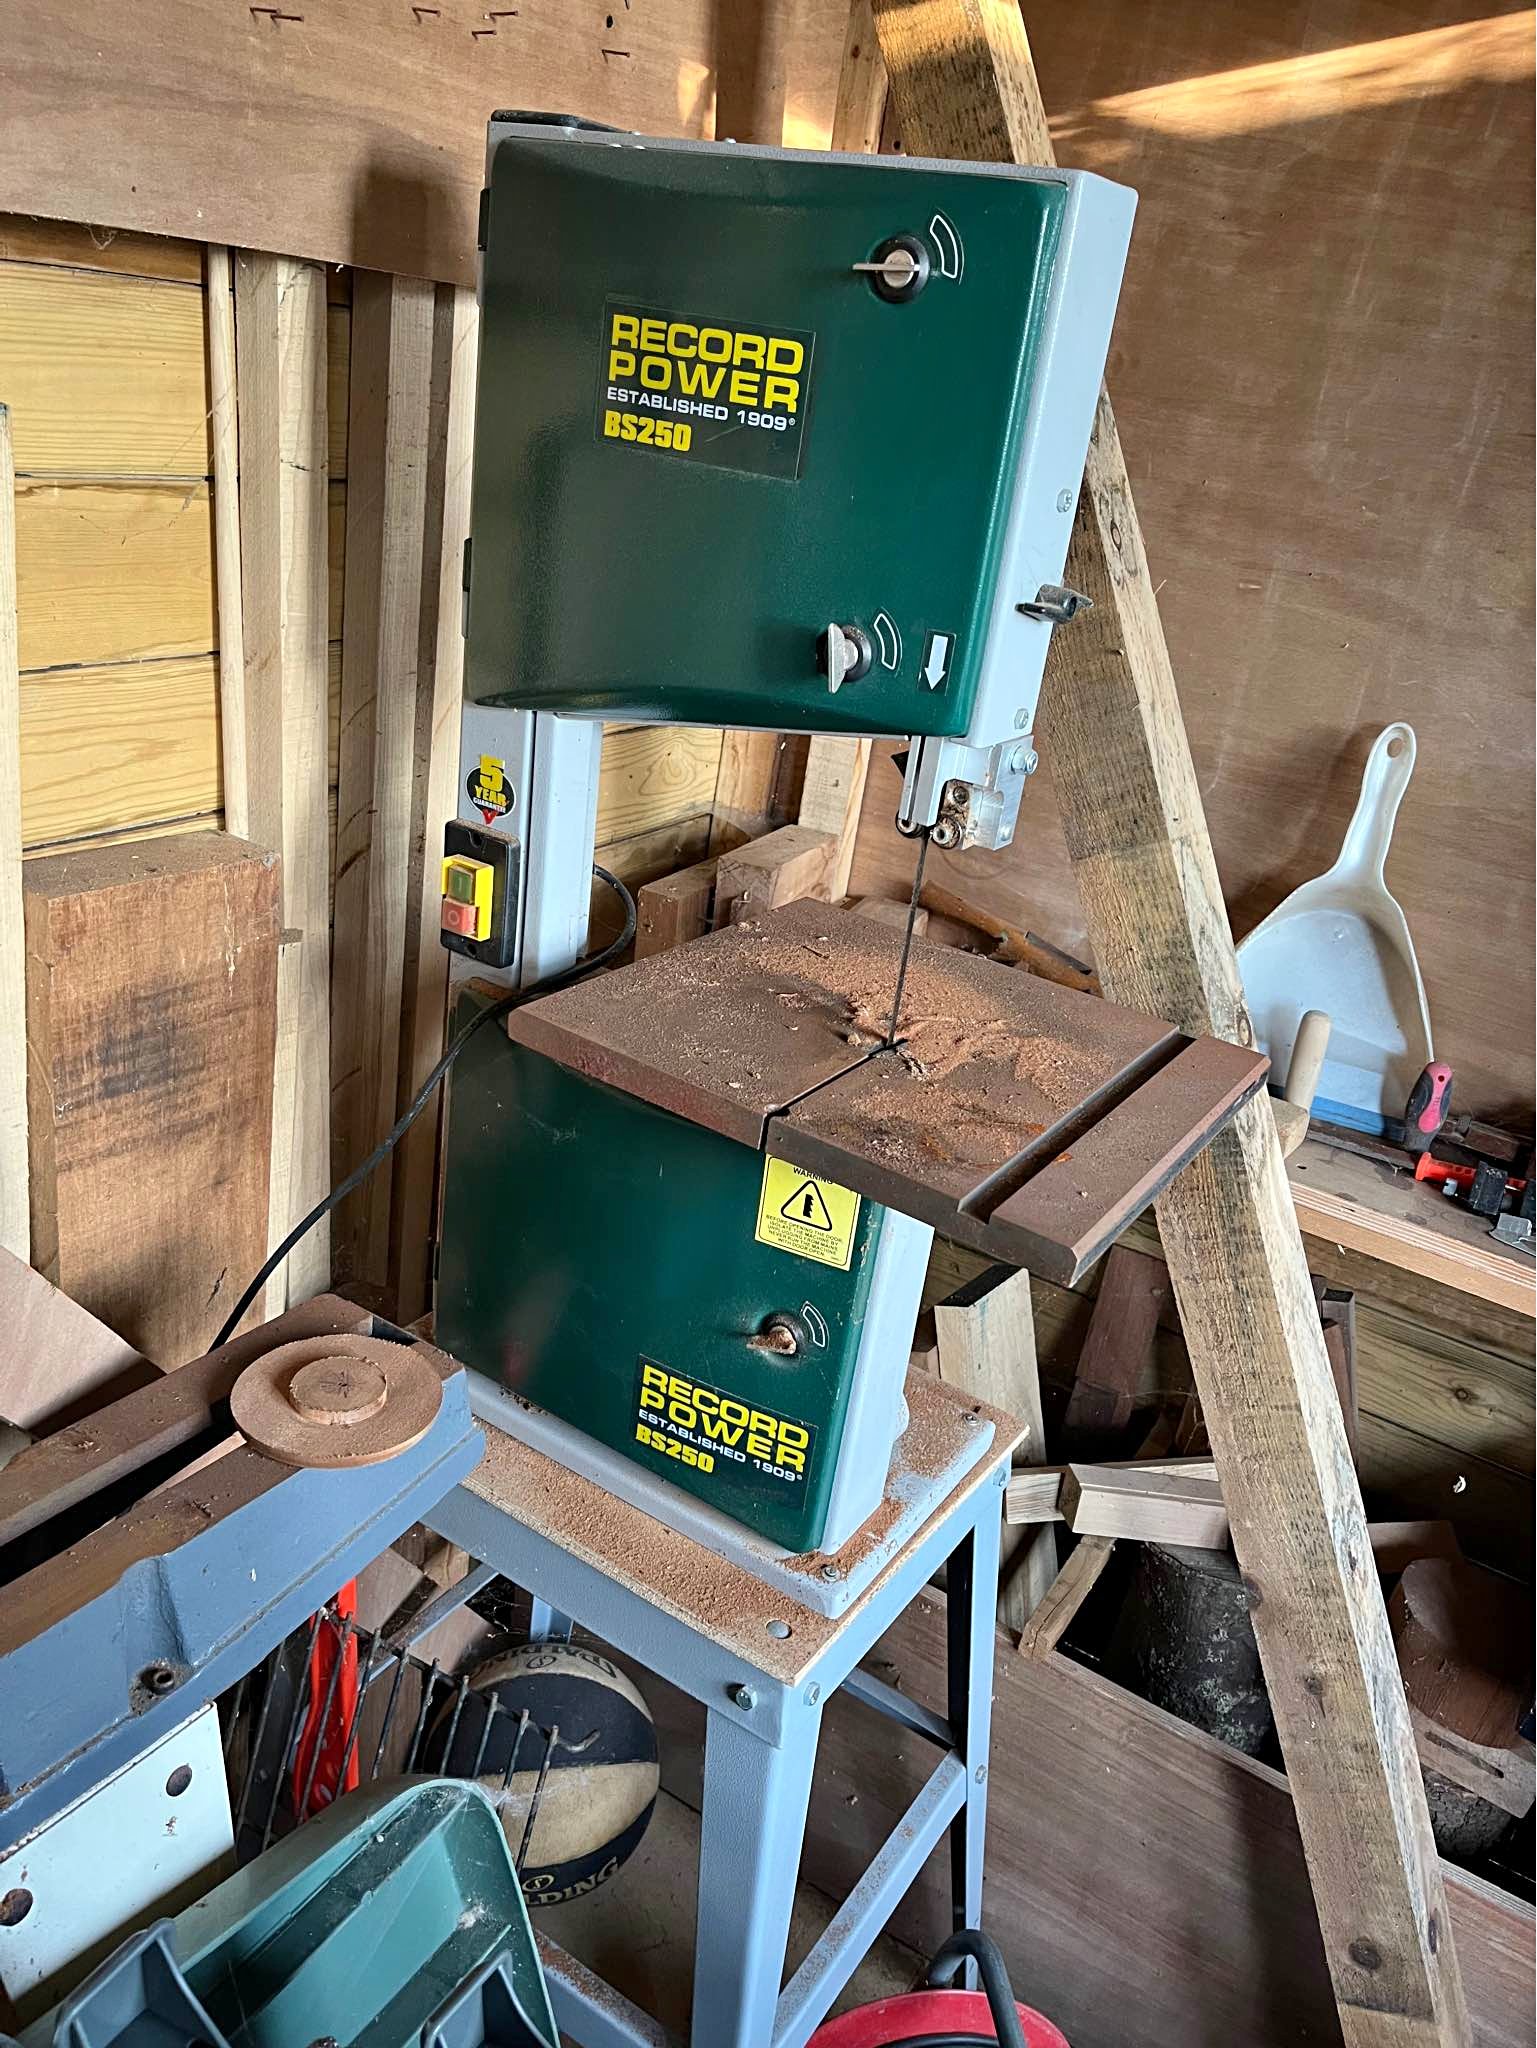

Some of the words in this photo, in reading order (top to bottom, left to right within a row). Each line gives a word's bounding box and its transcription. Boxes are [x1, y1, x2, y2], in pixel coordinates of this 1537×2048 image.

[611, 313, 804, 375] RECORD
[608, 349, 800, 413] POWER
[607, 386, 729, 421] ESTABLISHED
[604, 410, 692, 452] BS250
[480, 755, 505, 792] 5
[474, 785, 507, 807] YEAR
[766, 1214, 787, 1225] BEFORE
[789, 1221, 813, 1233] OPENING
[814, 1229, 825, 1237] THE
[768, 1229, 787, 1239] NEVER
[800, 1240, 811, 1248] THE
[811, 1244, 837, 1255] MACHINE
[769, 1221, 792, 1231] ISOLATE
[794, 1227, 803, 1235] THE
[804, 1232, 829, 1243] MACHINE
[777, 1238, 792, 1246] WITH
[792, 1242, 808, 1251] DOOR
[804, 1236, 820, 1246] FROM
[642, 1364, 809, 1450] RECORD
[635, 1423, 715, 1473] BS250
[638, 1408, 747, 1463] ESTABLISHED
[640, 1385, 806, 1473] POWER
[522, 1856, 619, 1905] LDING
